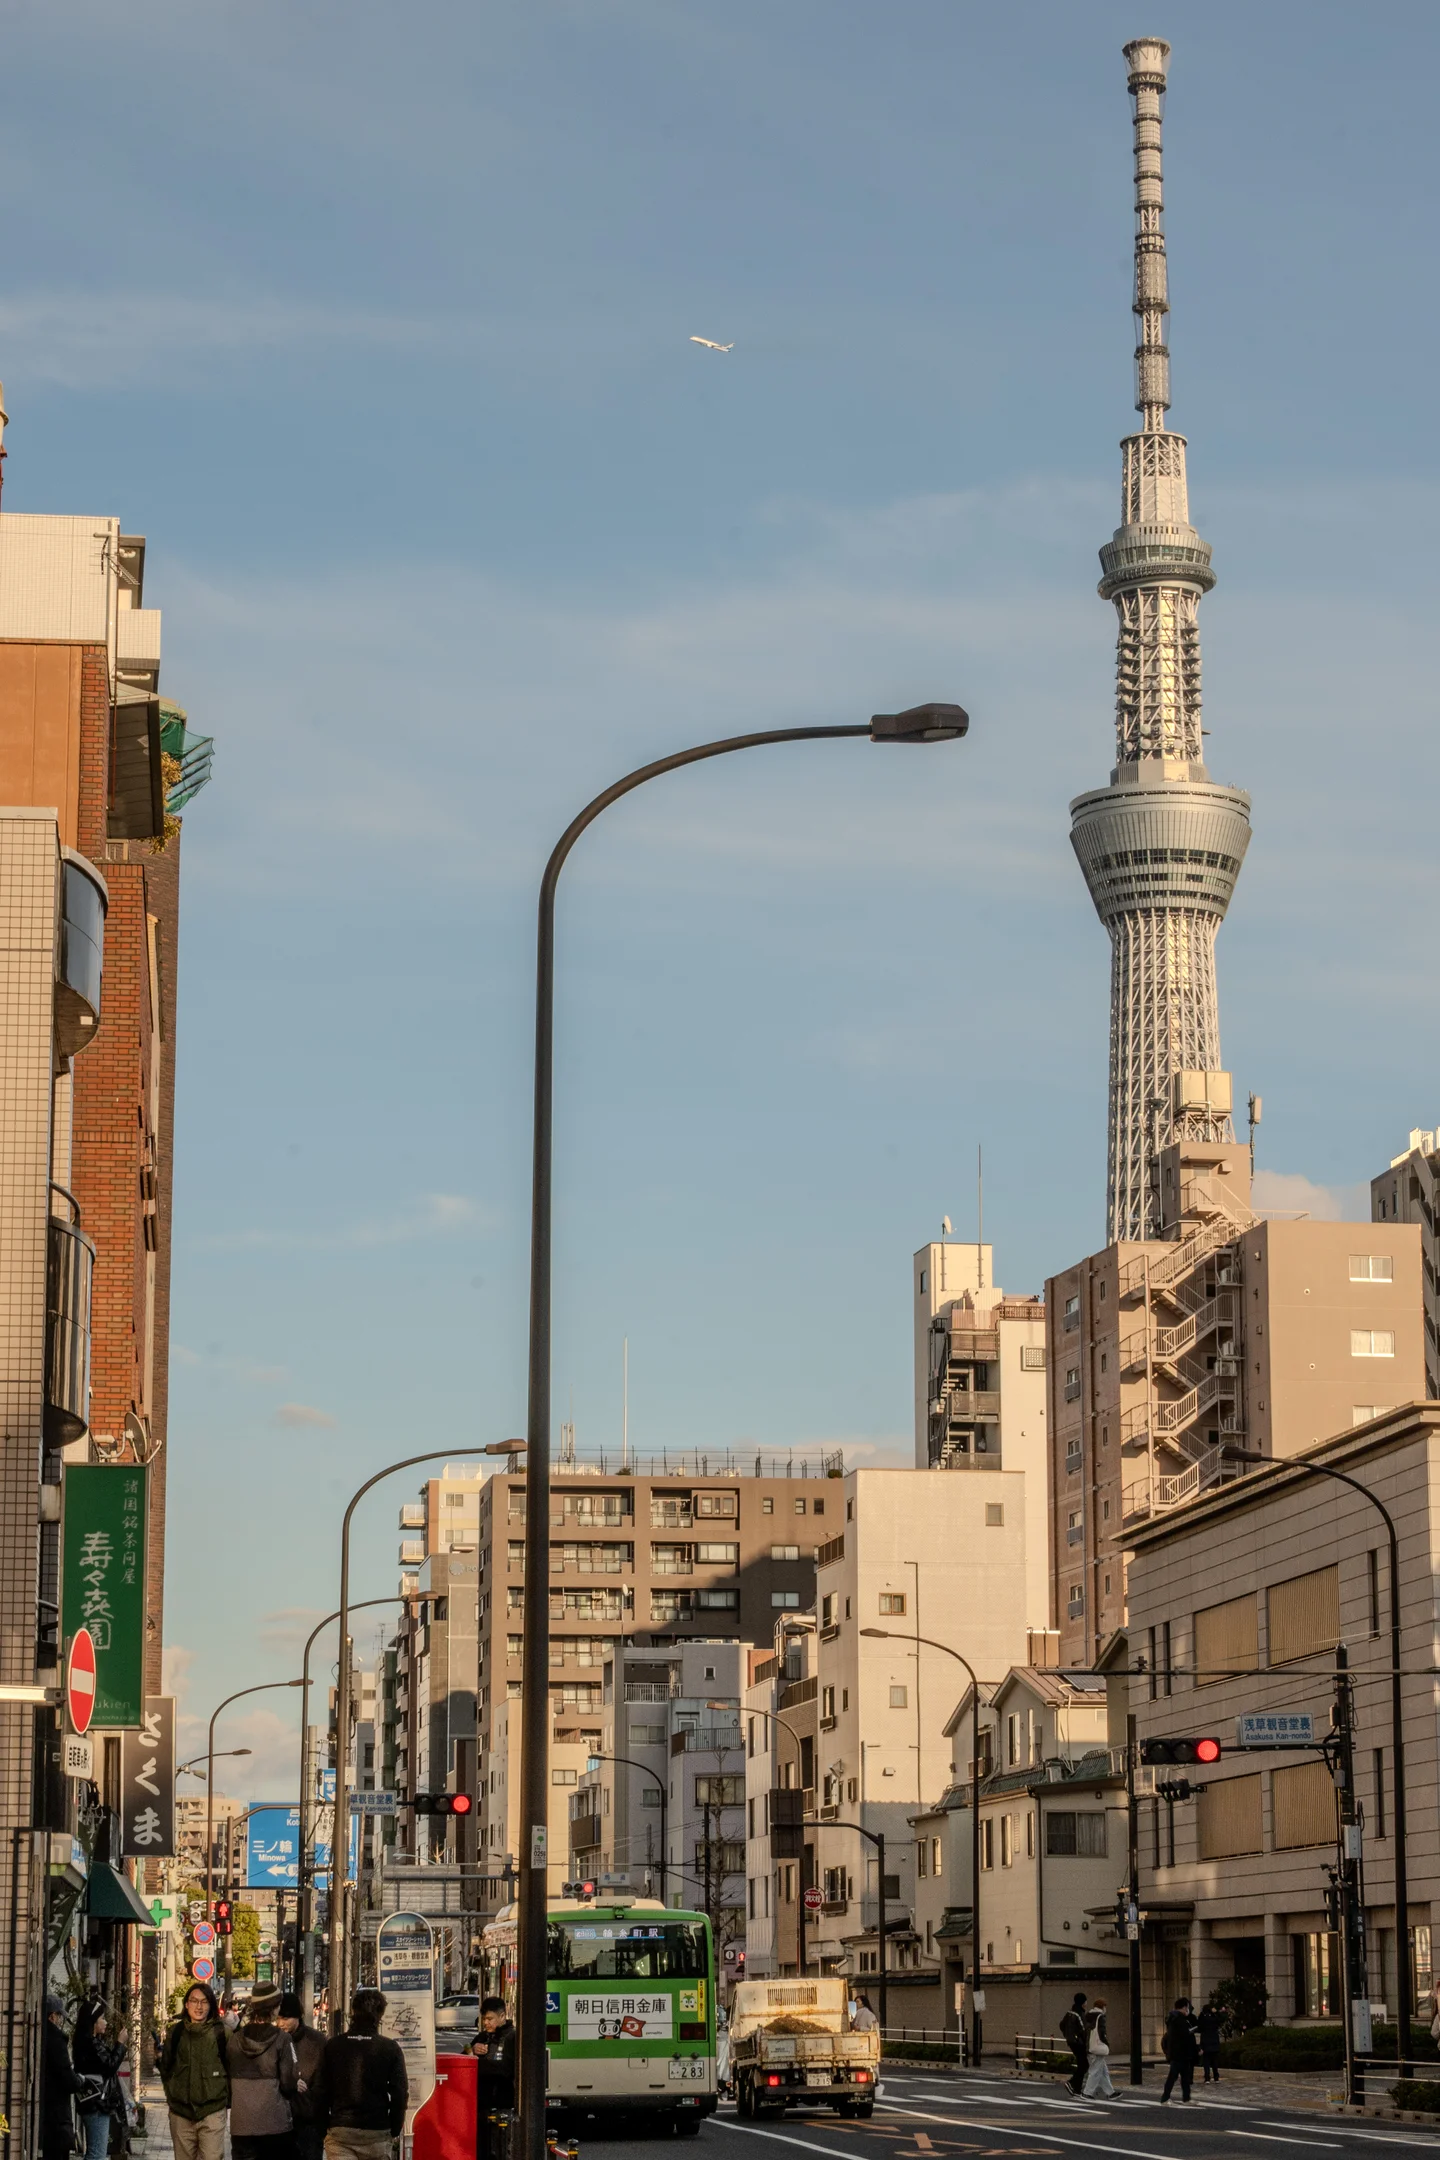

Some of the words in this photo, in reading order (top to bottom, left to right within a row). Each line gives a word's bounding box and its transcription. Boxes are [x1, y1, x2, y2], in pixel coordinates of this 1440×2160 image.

[94, 1699, 131, 1709] ukien
[1244, 1717, 1311, 1732] 浅草観音堂裏
[1245, 1733, 1274, 1741] Asakusa
[1275, 1732, 1312, 1740] Kan-nondo
[133, 1711, 163, 1846] さくま
[350, 1793, 394, 1805] 草観音堂裏
[252, 1840, 293, 1854] 三ノ輪
[258, 1854, 286, 1862] Minowa
[574, 1998, 667, 2015] 朝日信用金庫
